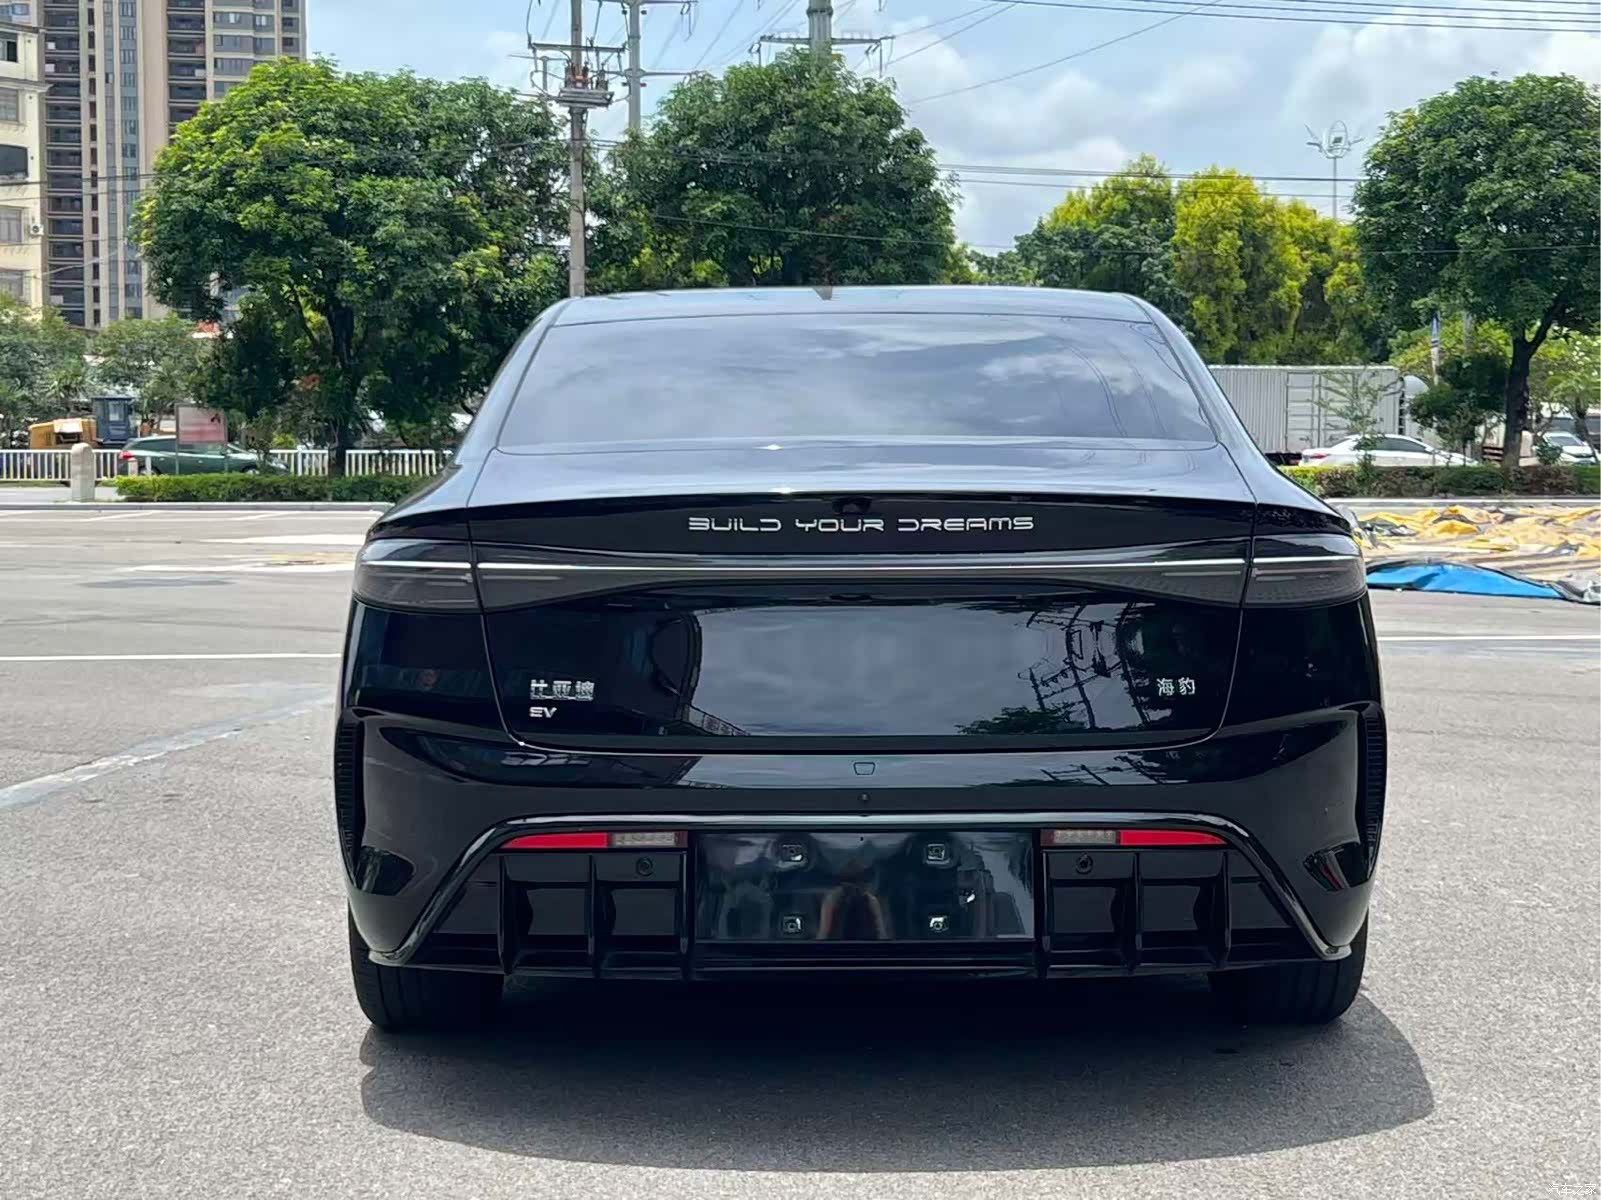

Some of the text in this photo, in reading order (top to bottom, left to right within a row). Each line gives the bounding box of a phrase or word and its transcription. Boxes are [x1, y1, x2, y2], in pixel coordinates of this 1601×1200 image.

[688, 516, 1034, 532] BUILD YOUR DREAMS
[1156, 677, 1196, 696] 海豹
[529, 706, 558, 718] EV
